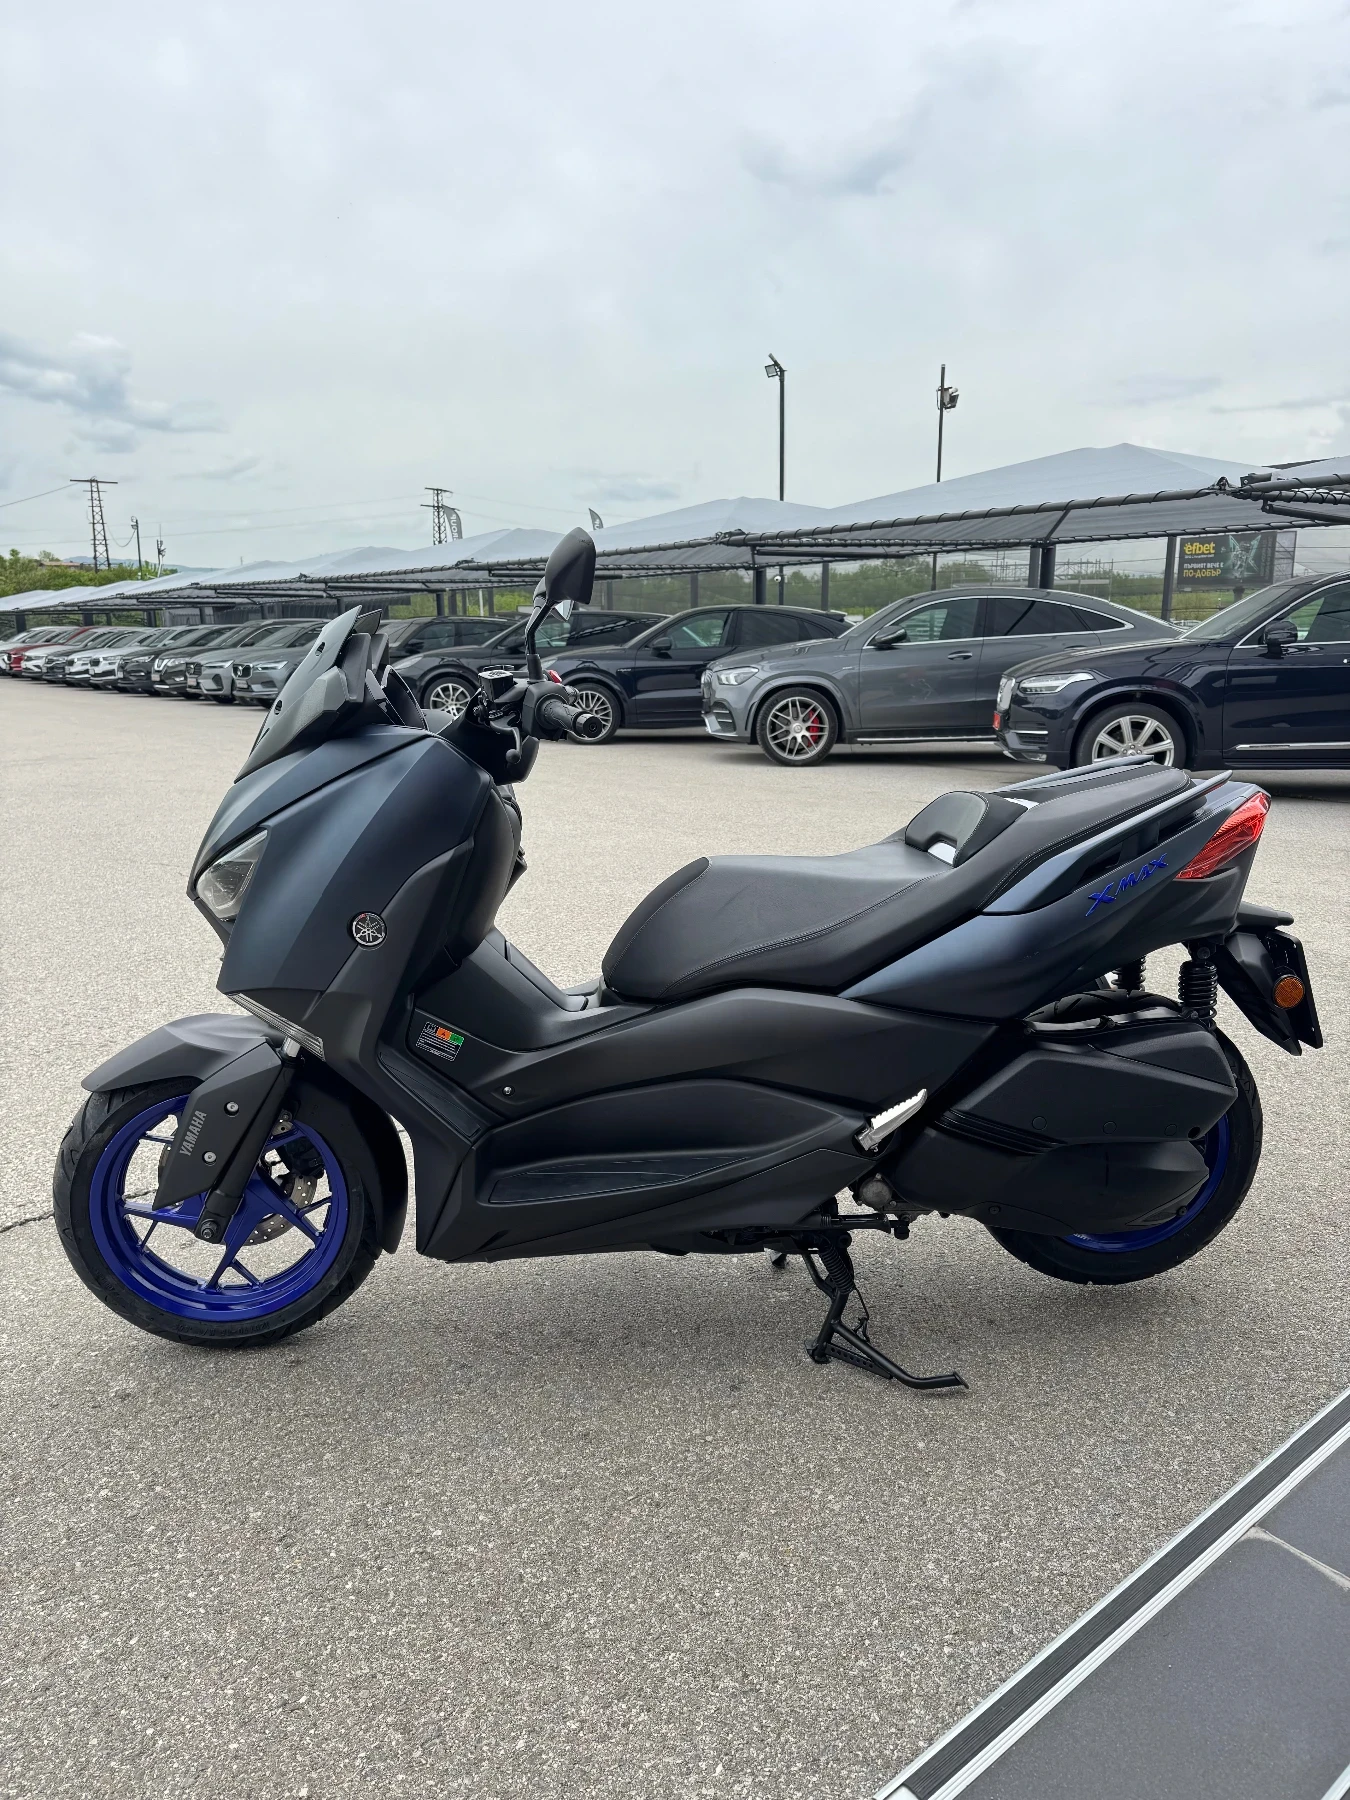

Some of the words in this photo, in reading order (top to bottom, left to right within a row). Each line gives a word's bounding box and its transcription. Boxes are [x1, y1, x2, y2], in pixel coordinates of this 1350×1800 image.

[1184, 542, 1216, 554] efbet
[1183, 569, 1221, 578] ПО-ДОБЪР
[179, 1110, 207, 1157] YAMAHA
